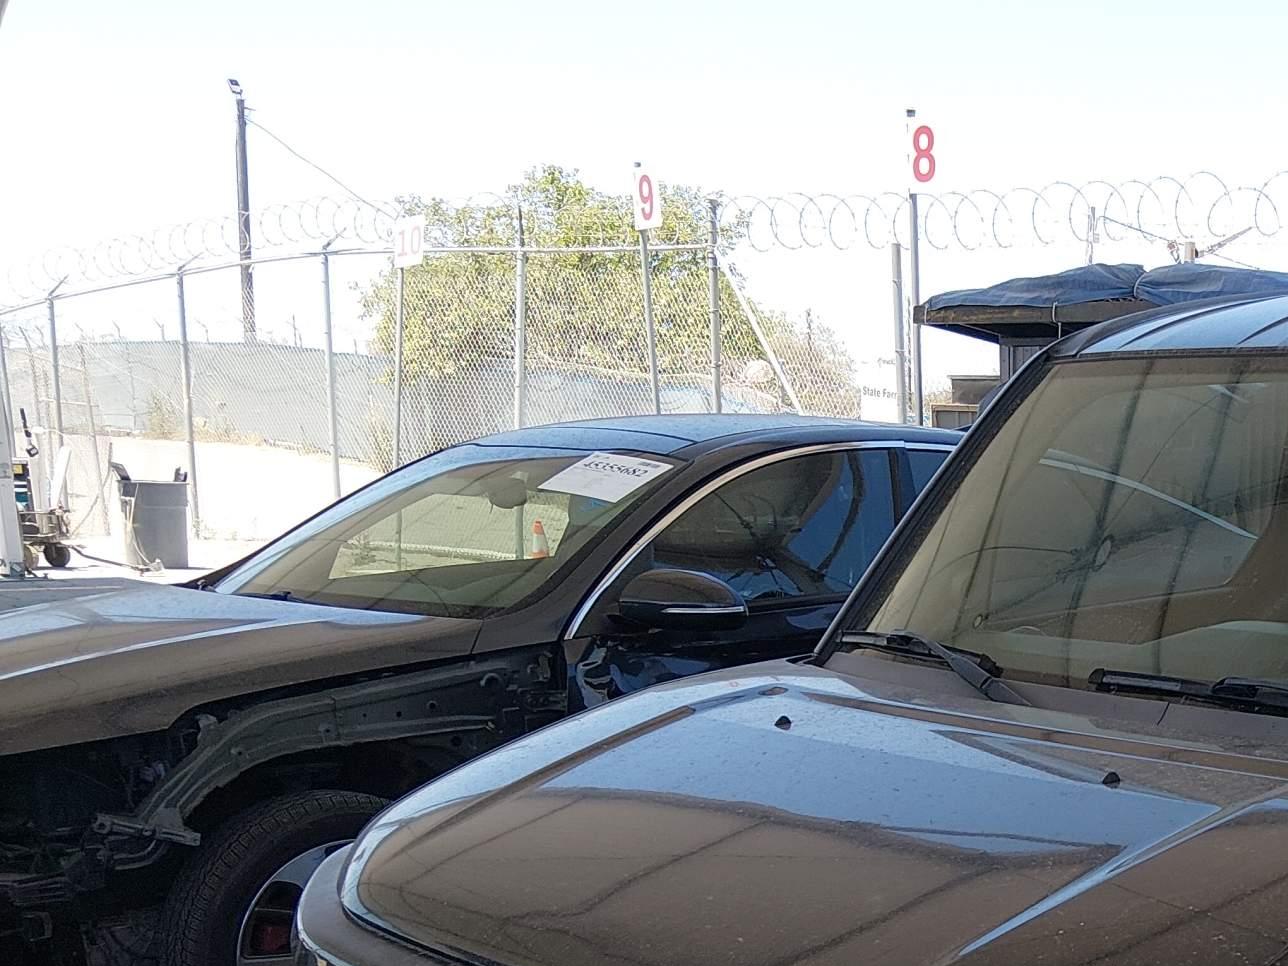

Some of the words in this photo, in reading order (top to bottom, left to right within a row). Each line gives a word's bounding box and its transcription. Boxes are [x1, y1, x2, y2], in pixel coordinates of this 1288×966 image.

[913, 125, 936, 182] 8
[639, 174, 653, 221] 9
[398, 226, 421, 256] 10
[862, 386, 881, 398] State
[882, 388, 897, 399] Far
